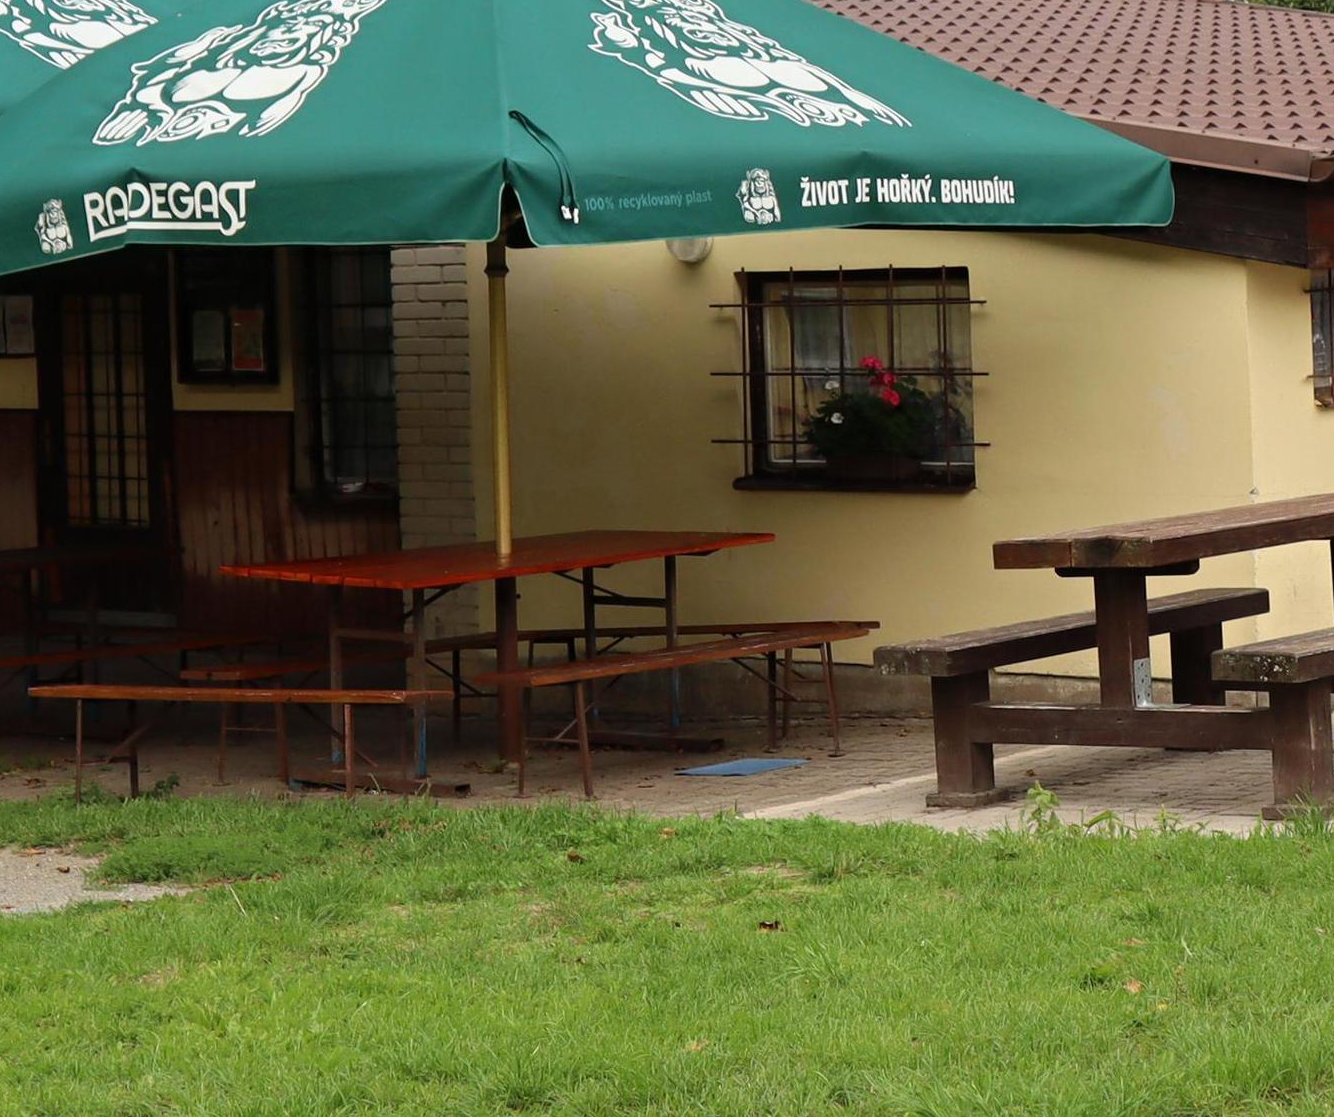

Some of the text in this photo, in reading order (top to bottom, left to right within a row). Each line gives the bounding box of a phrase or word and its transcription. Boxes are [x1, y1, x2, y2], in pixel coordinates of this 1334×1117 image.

[584, 189, 713, 212] 100% recyklovaný plast
[800, 173, 1016, 207] ŽIVOT JE HOŘKÝ. BOHUDÍK!
[83, 179, 257, 242] RADEGAST
